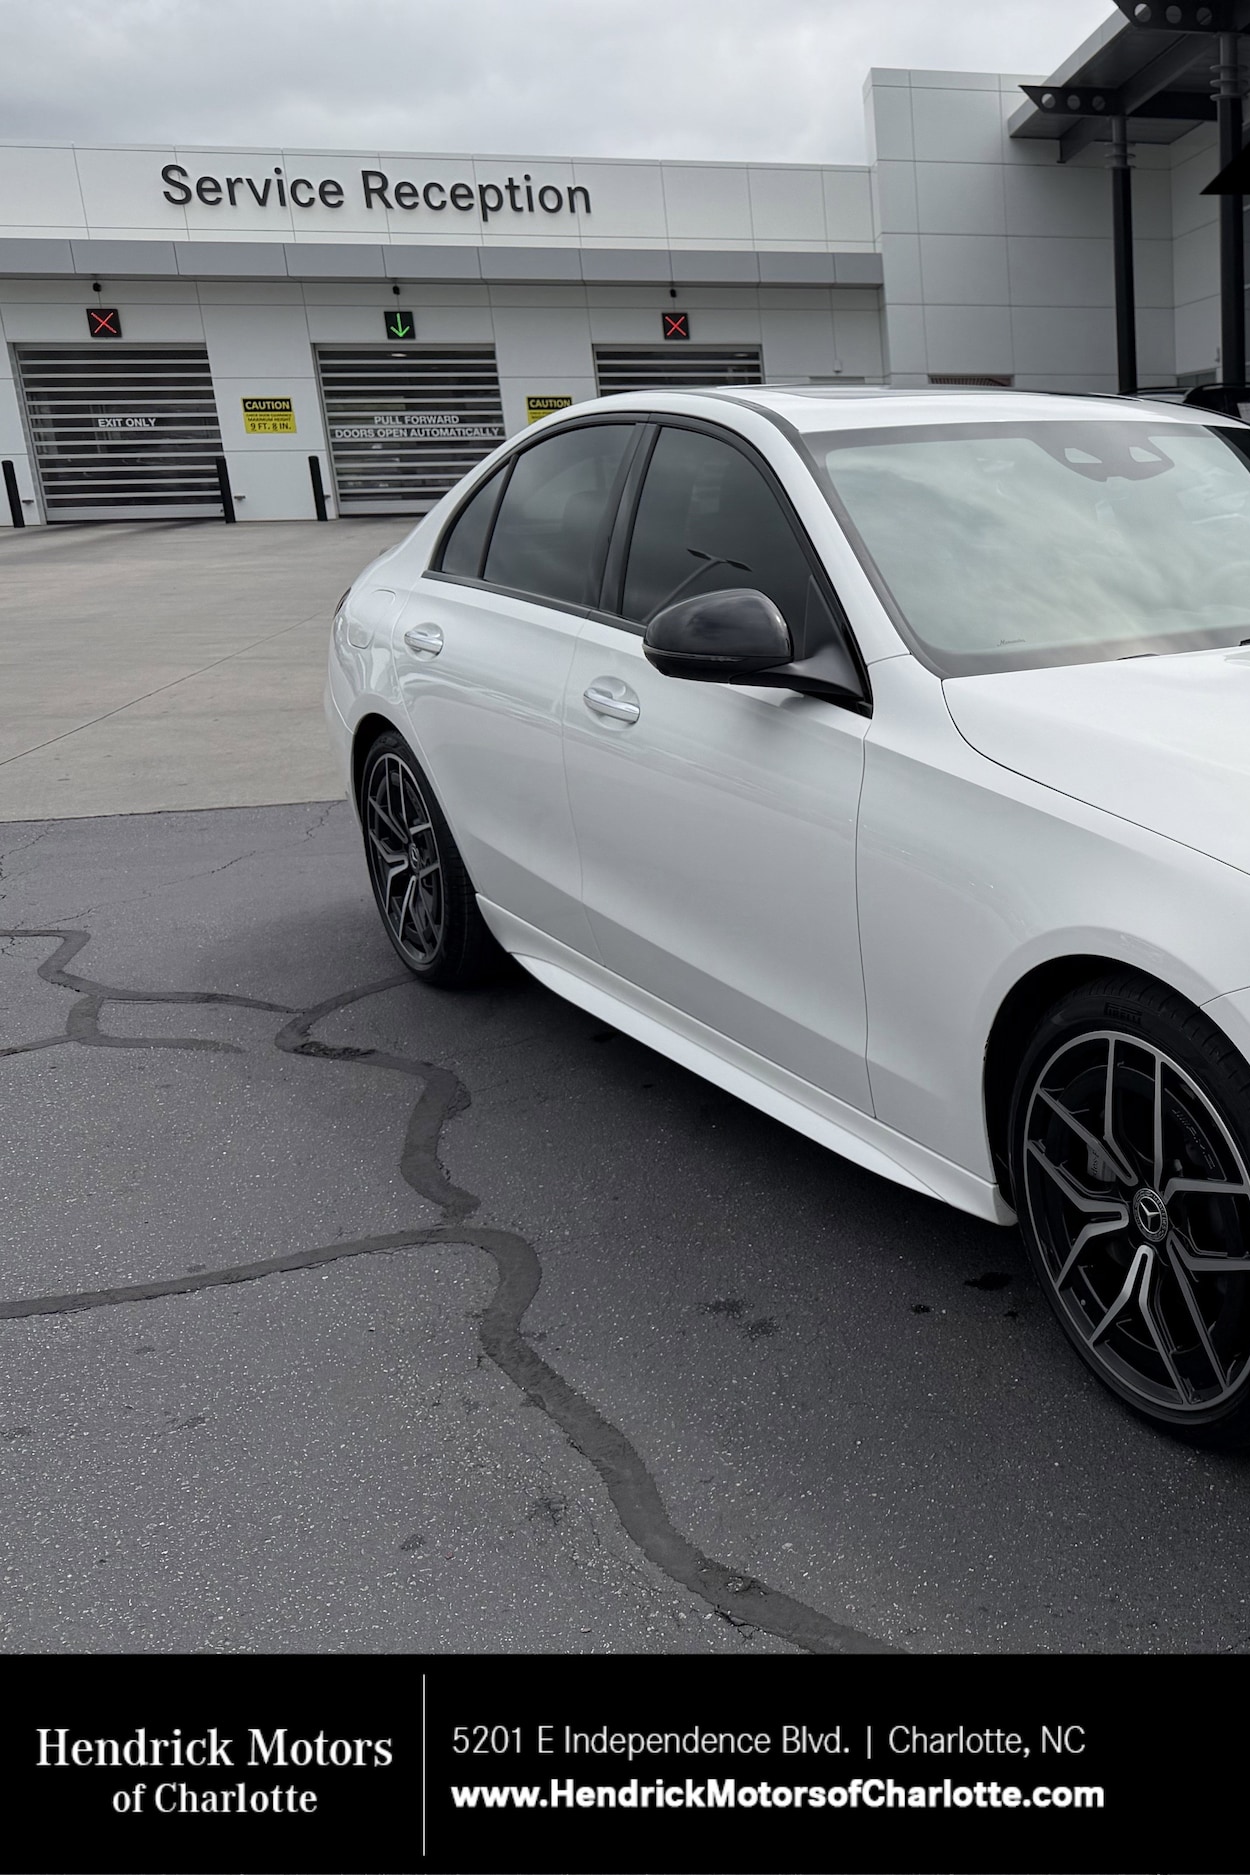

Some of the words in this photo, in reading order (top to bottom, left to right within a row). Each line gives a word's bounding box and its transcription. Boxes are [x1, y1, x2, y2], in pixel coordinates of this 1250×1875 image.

[161, 164, 344, 208] Service
[361, 170, 592, 223] Reception
[245, 401, 290, 410] CAUTION
[529, 399, 571, 408] CAUTION
[98, 418, 122, 427] EXIT
[125, 418, 156, 427] ONLY
[374, 416, 402, 425] PULL
[404, 415, 460, 424] FORWARD
[279, 422, 291, 430] IN.
[335, 429, 375, 438] DOORS
[377, 429, 408, 438] OPEN
[410, 428, 499, 437] AUTOMATICALLY
